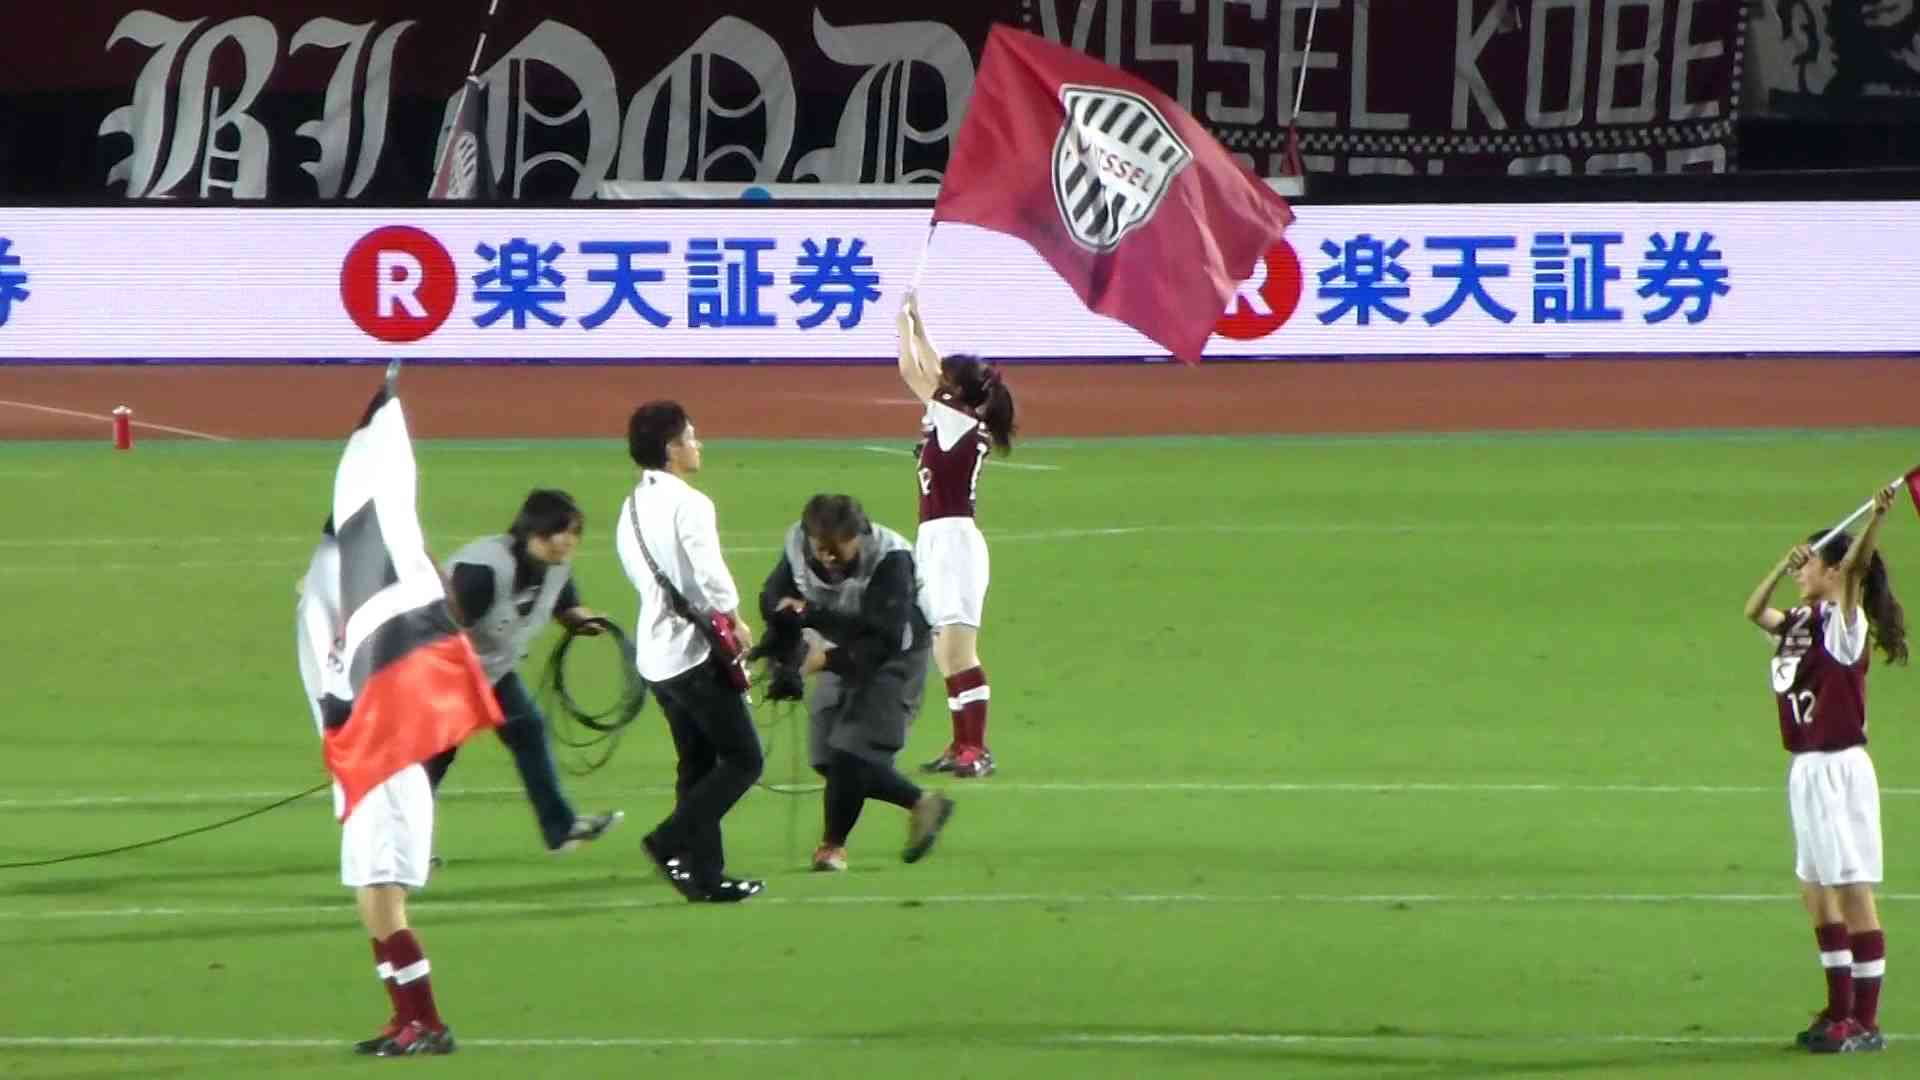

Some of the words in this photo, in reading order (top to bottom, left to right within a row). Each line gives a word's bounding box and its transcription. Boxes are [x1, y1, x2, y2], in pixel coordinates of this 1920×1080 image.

[1451, 0, 1724, 131] KOBE
[472, 237, 882, 331] 楽天証券
[1317, 232, 1731, 326] 楽天証券
[1787, 690, 1817, 724] 12
